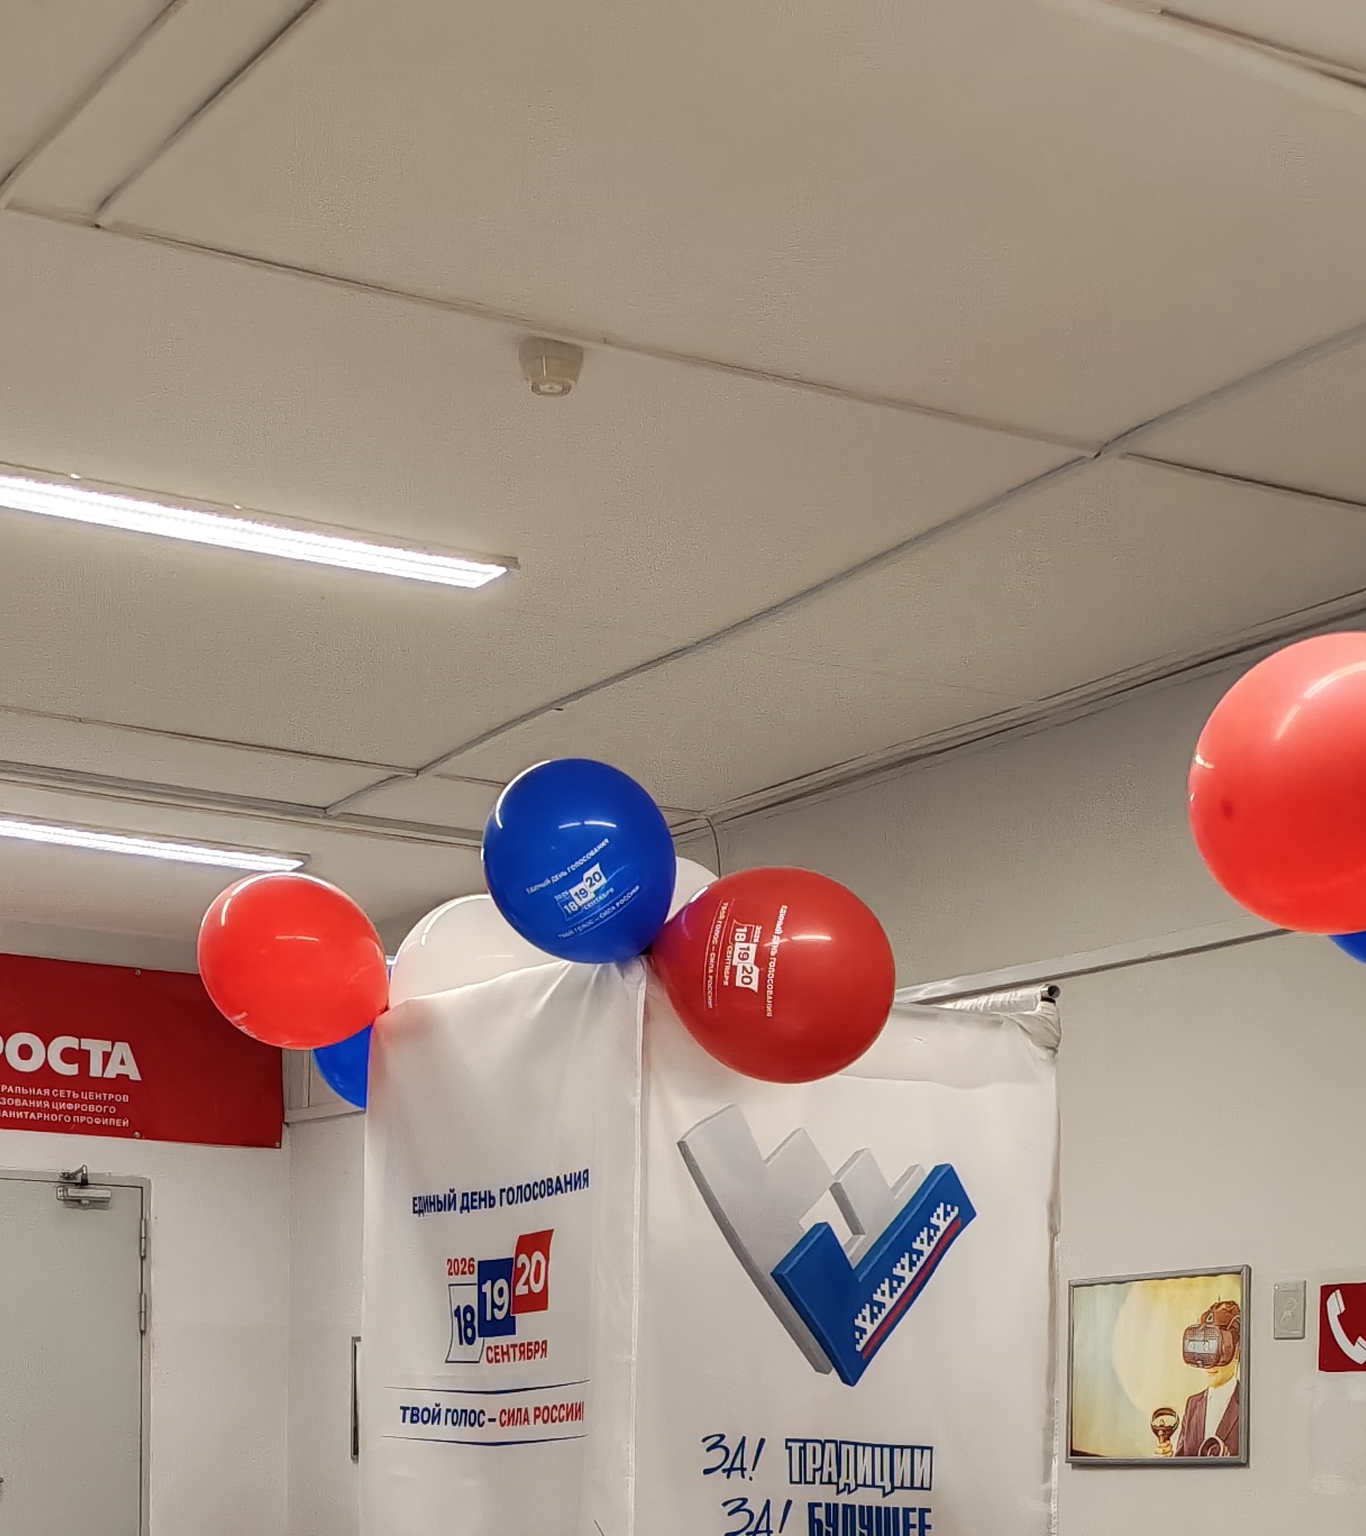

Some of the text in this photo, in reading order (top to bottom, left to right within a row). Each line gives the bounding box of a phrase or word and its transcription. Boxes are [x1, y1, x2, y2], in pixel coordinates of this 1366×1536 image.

[564, 871, 602, 914] 18 19 20
[735, 926, 753, 985] 18 19 20
[51, 1101, 116, 1114] ЦИФРОВОГО
[52, 1089, 79, 1099] СЕТЬ
[80, 1092, 129, 1103] ЦЕНТРОВ
[412, 1169, 589, 1216] ЕДИНЫЙ ДЕНЬ ГОЛОСОВАНИЯ
[447, 1257, 475, 1276] 2026
[454, 1251, 546, 1345] 18 19 20
[486, 1340, 548, 1364] СЕНТЯБРЯ
[400, 1403, 441, 1425] ТВОЙ
[445, 1408, 485, 1427] ГОЛОС
[499, 1409, 530, 1427] СИЛА
[701, 1433, 933, 1497] ЗА! ТРАДИЦИИ
